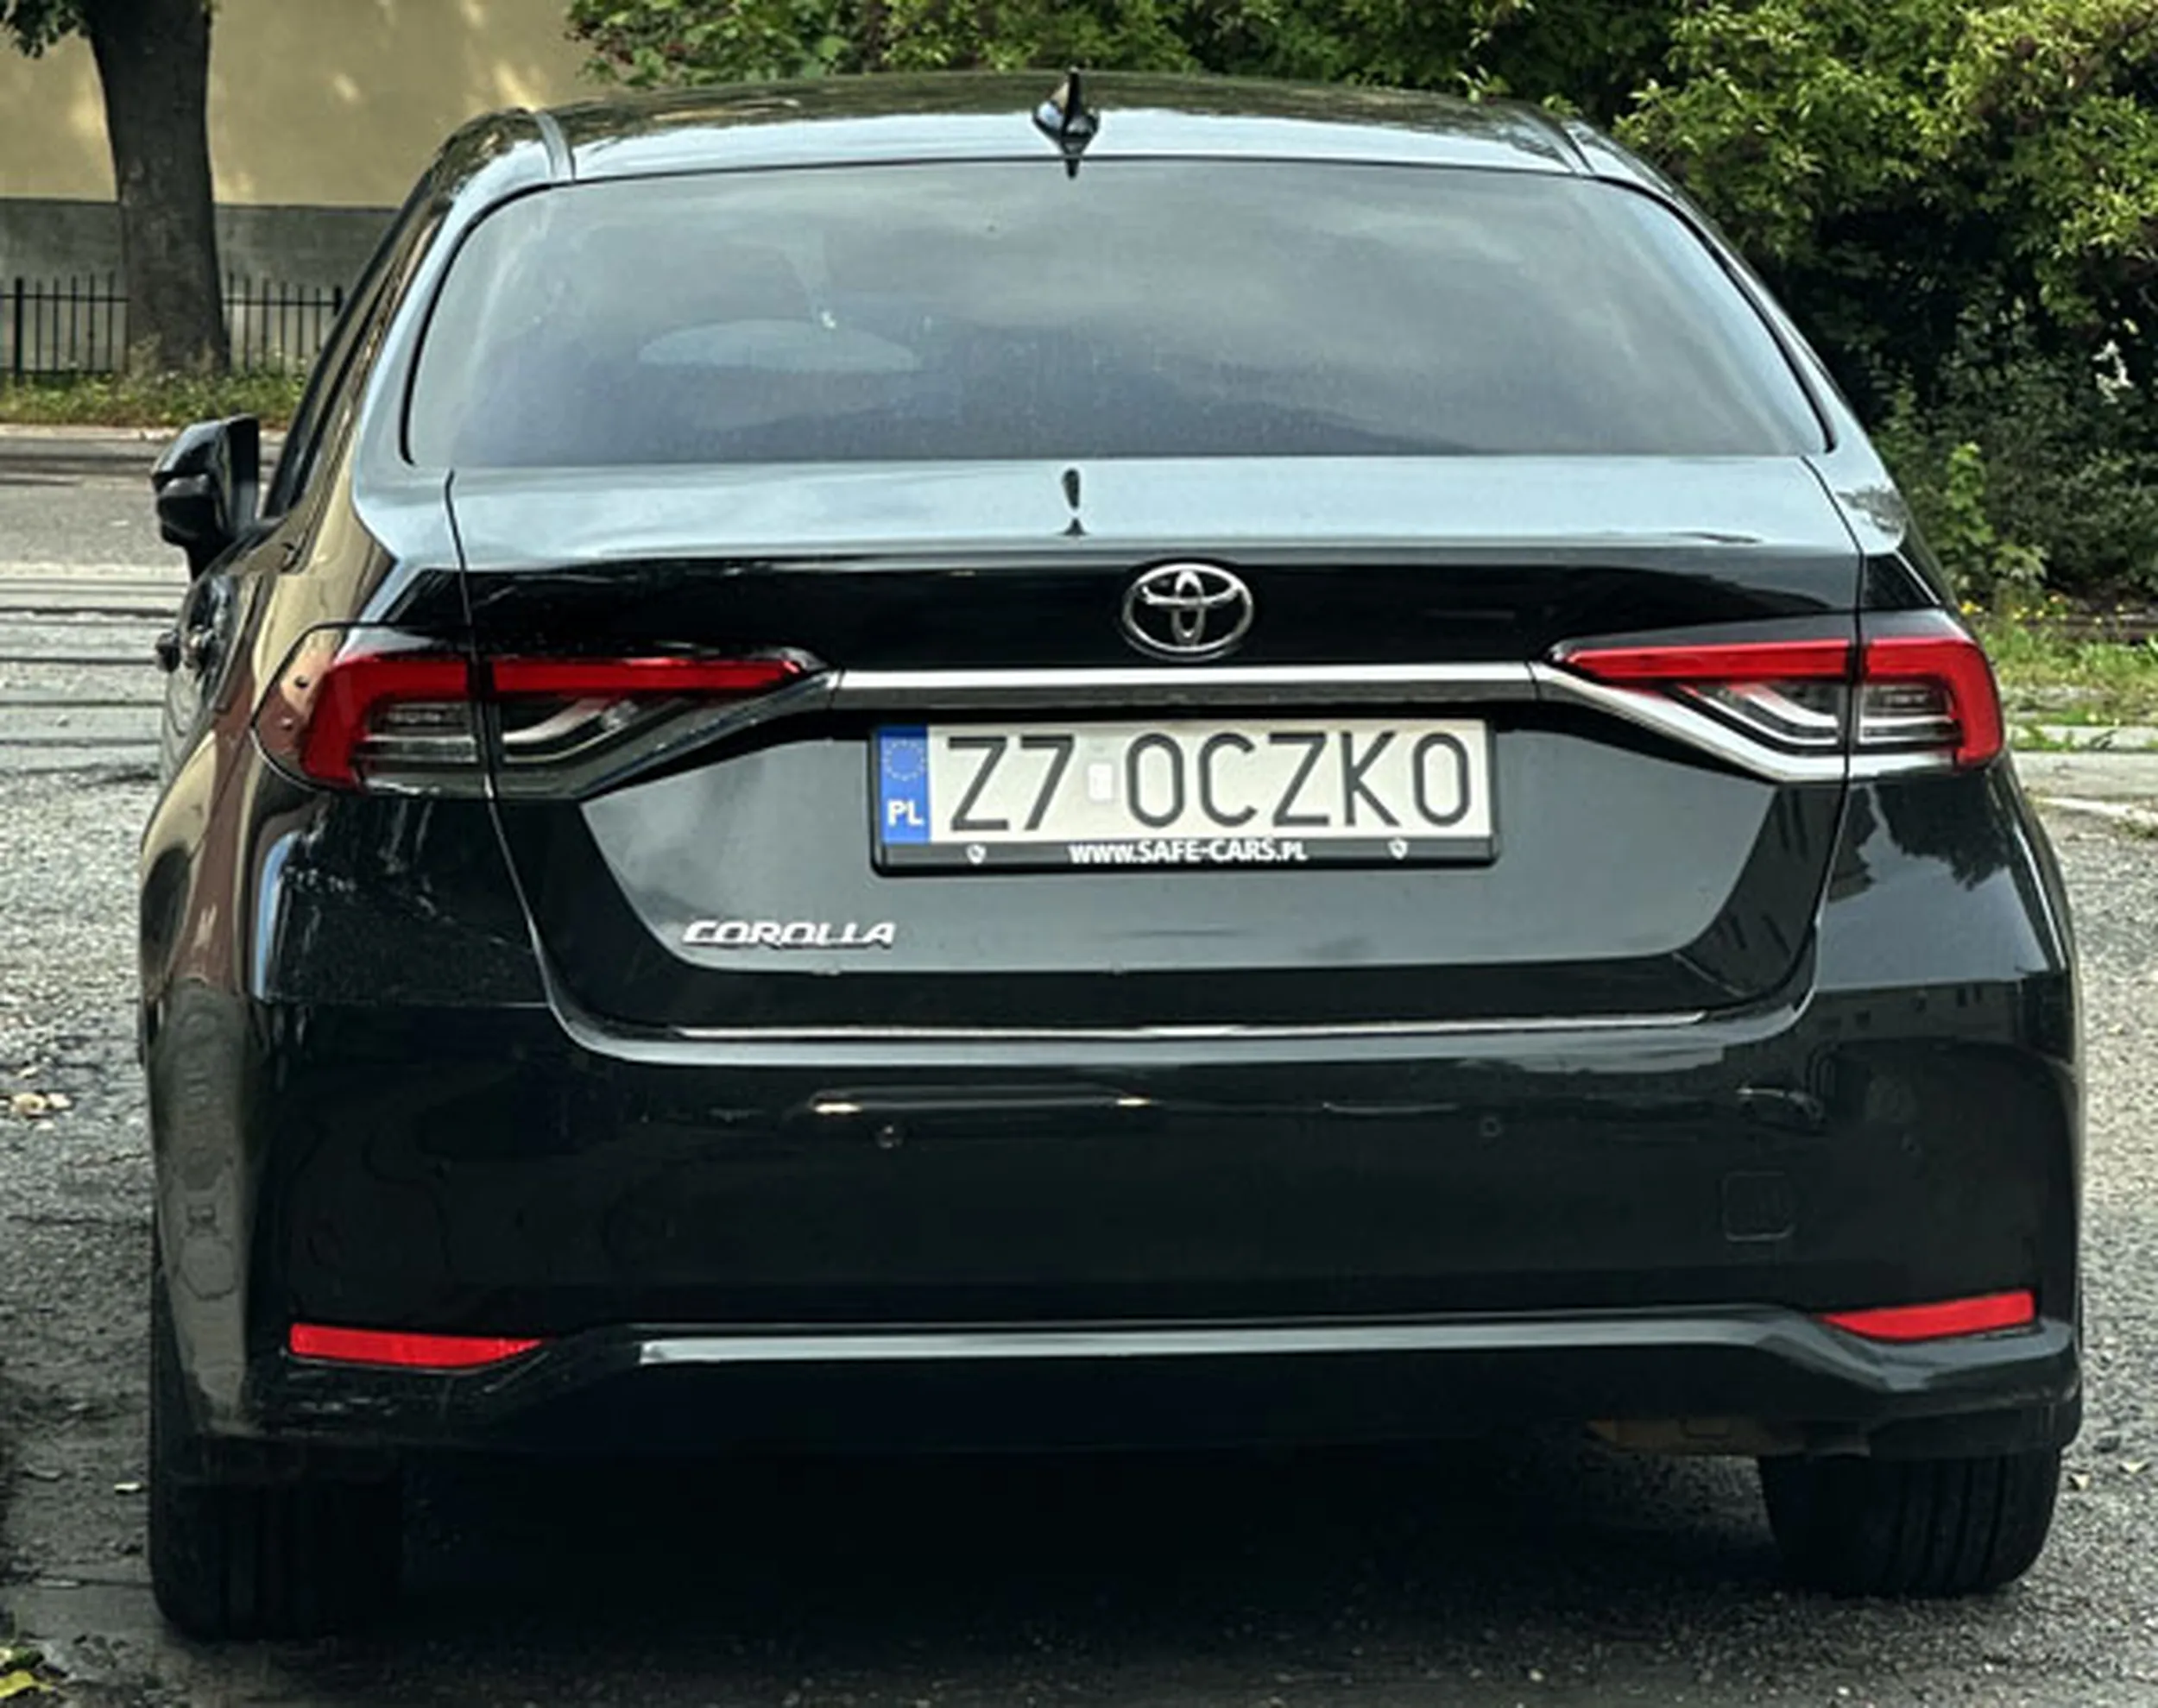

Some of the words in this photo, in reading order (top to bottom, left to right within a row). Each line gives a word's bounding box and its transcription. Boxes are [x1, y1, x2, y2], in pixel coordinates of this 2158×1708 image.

[948, 734, 1076, 831] Z7
[1125, 731, 1471, 827] OCZKO
[887, 800, 923, 825] PL
[682, 920, 896, 948] COROLLA
